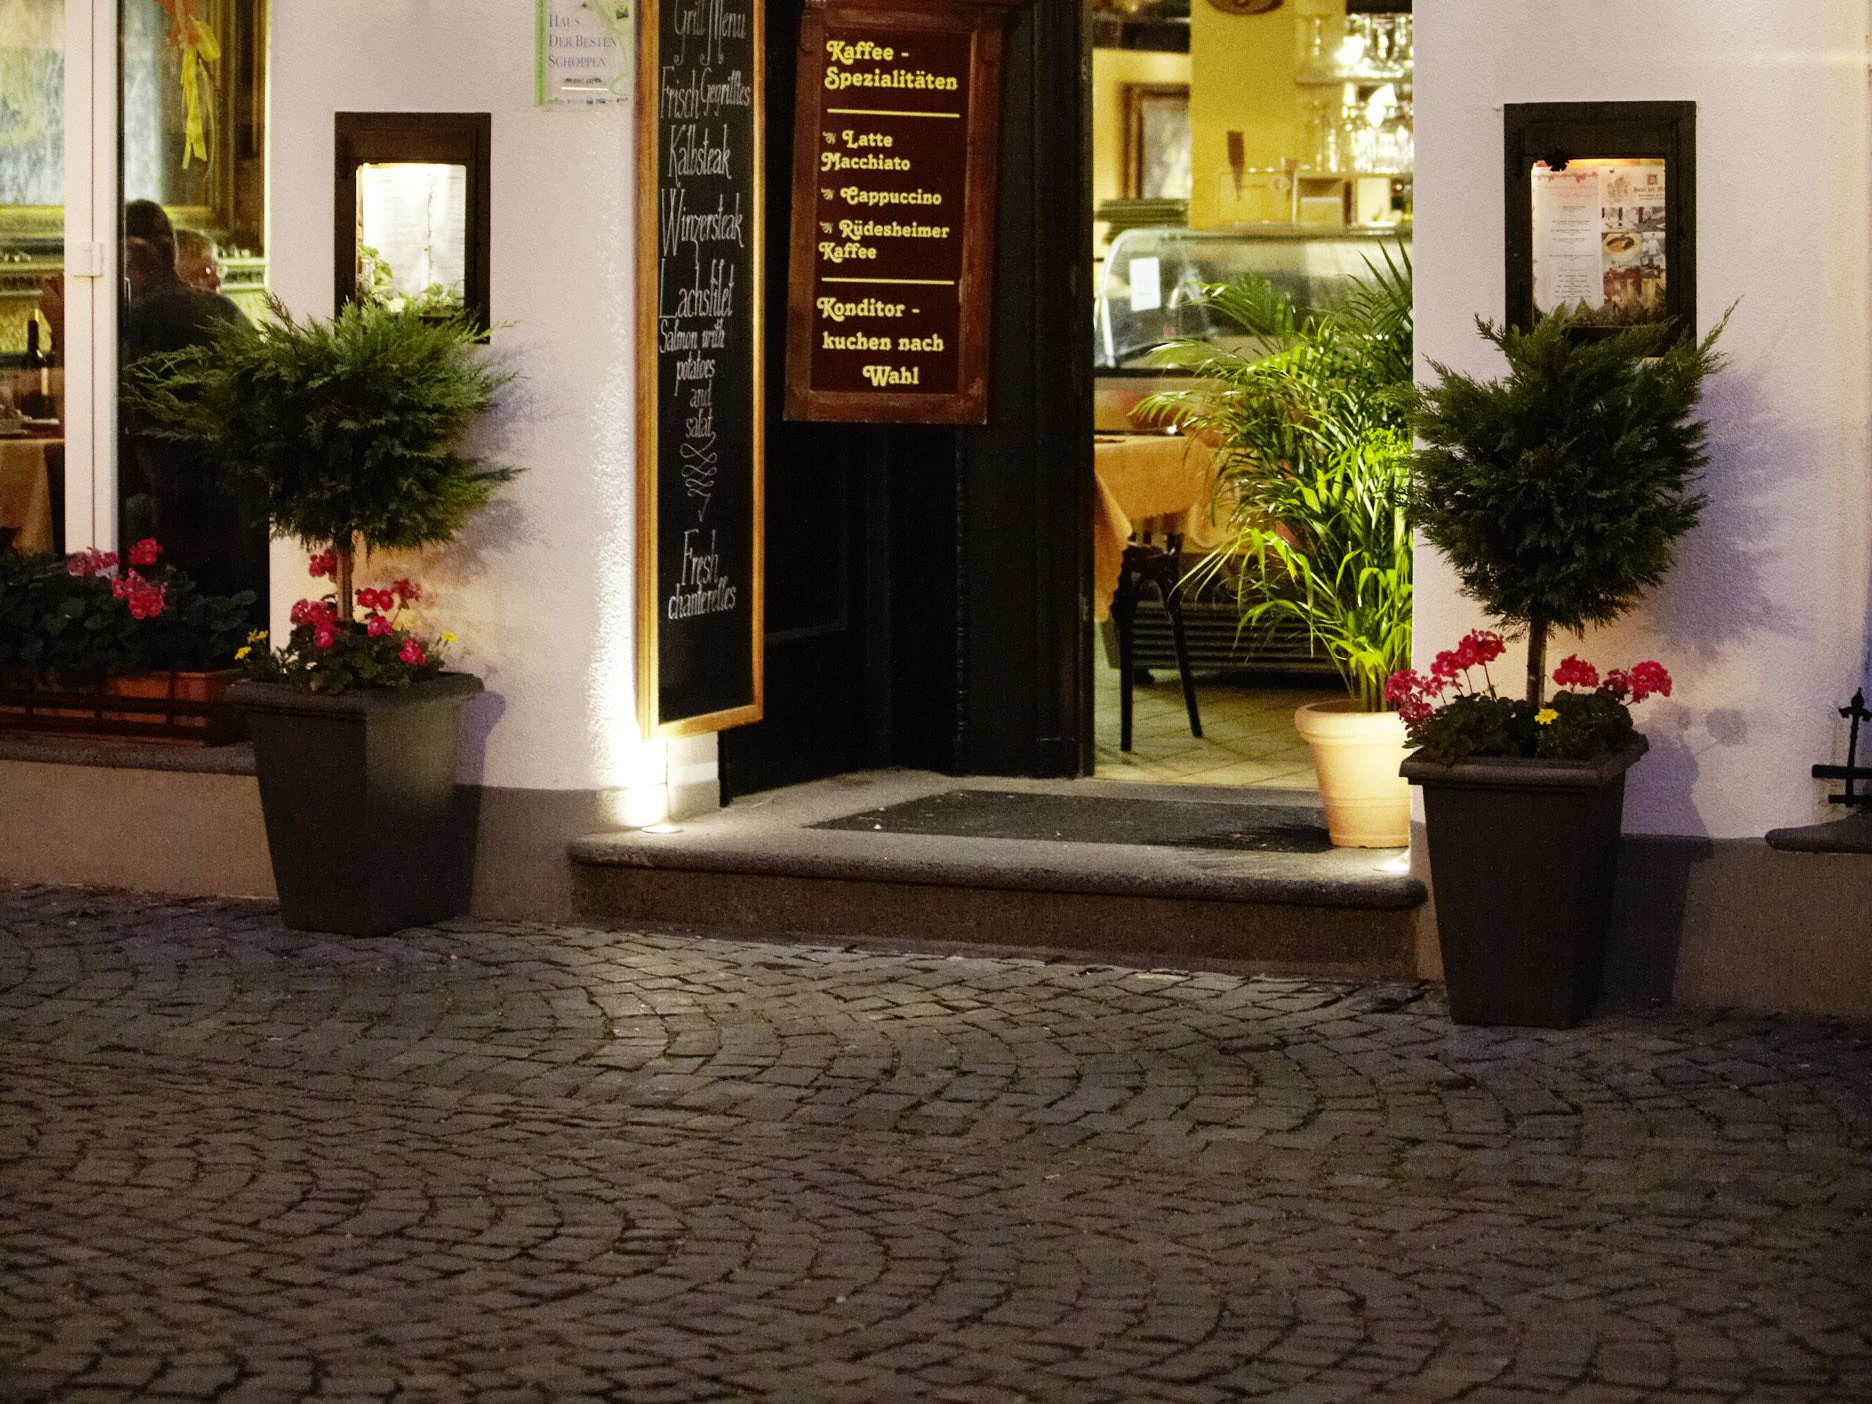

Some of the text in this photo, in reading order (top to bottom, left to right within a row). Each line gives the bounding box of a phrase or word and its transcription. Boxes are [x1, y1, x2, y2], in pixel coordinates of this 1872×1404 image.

[826, 40, 894, 65] Kaffee
[824, 66, 958, 90] Spezialitäten
[660, 66, 699, 119] Frisch
[842, 130, 893, 148] Latte
[669, 124, 732, 188] Kalbsteak
[821, 152, 911, 172] Macchiato
[840, 186, 942, 206] Cappuccino
[661, 188, 744, 260] Winzersteak
[839, 219, 950, 240] Rüdesheimer
[818, 242, 877, 263] Kaffee
[659, 258, 733, 318] Lachsfilet
[816, 297, 905, 322] Konditor
[659, 318, 725, 353] Salmon with
[822, 331, 944, 352] kuchen nach
[674, 350, 715, 396] potatoes
[862, 365, 919, 387] Wahl
[689, 379, 712, 408] and
[681, 528, 718, 586] Fresh
[668, 576, 736, 619] chanterelles
